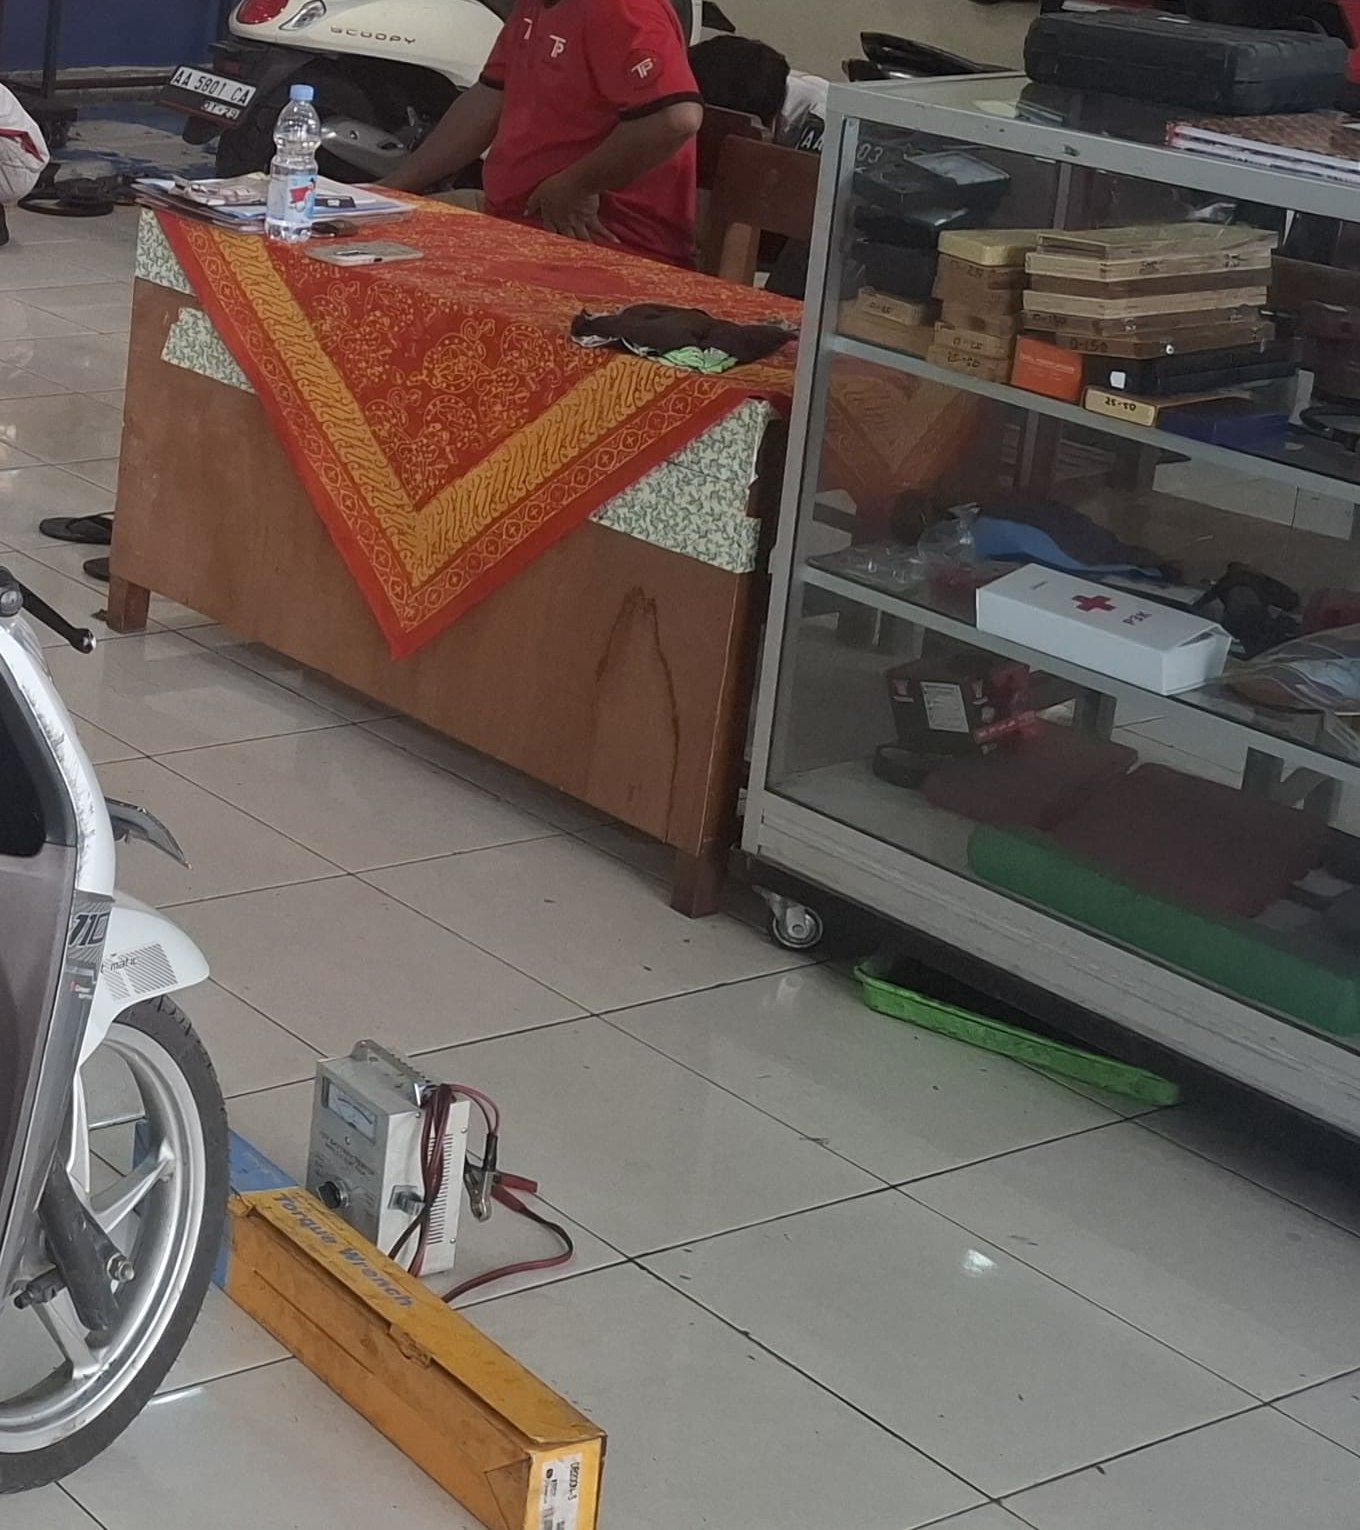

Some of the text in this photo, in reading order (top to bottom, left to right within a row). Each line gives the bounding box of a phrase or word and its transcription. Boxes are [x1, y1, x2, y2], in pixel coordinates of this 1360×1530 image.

[330, 26, 416, 44] SCOOPY
[173, 70, 250, 104] AA 5801 CA
[272, 1192, 339, 1245] Torque
[338, 1247, 414, 1308] Wrench
